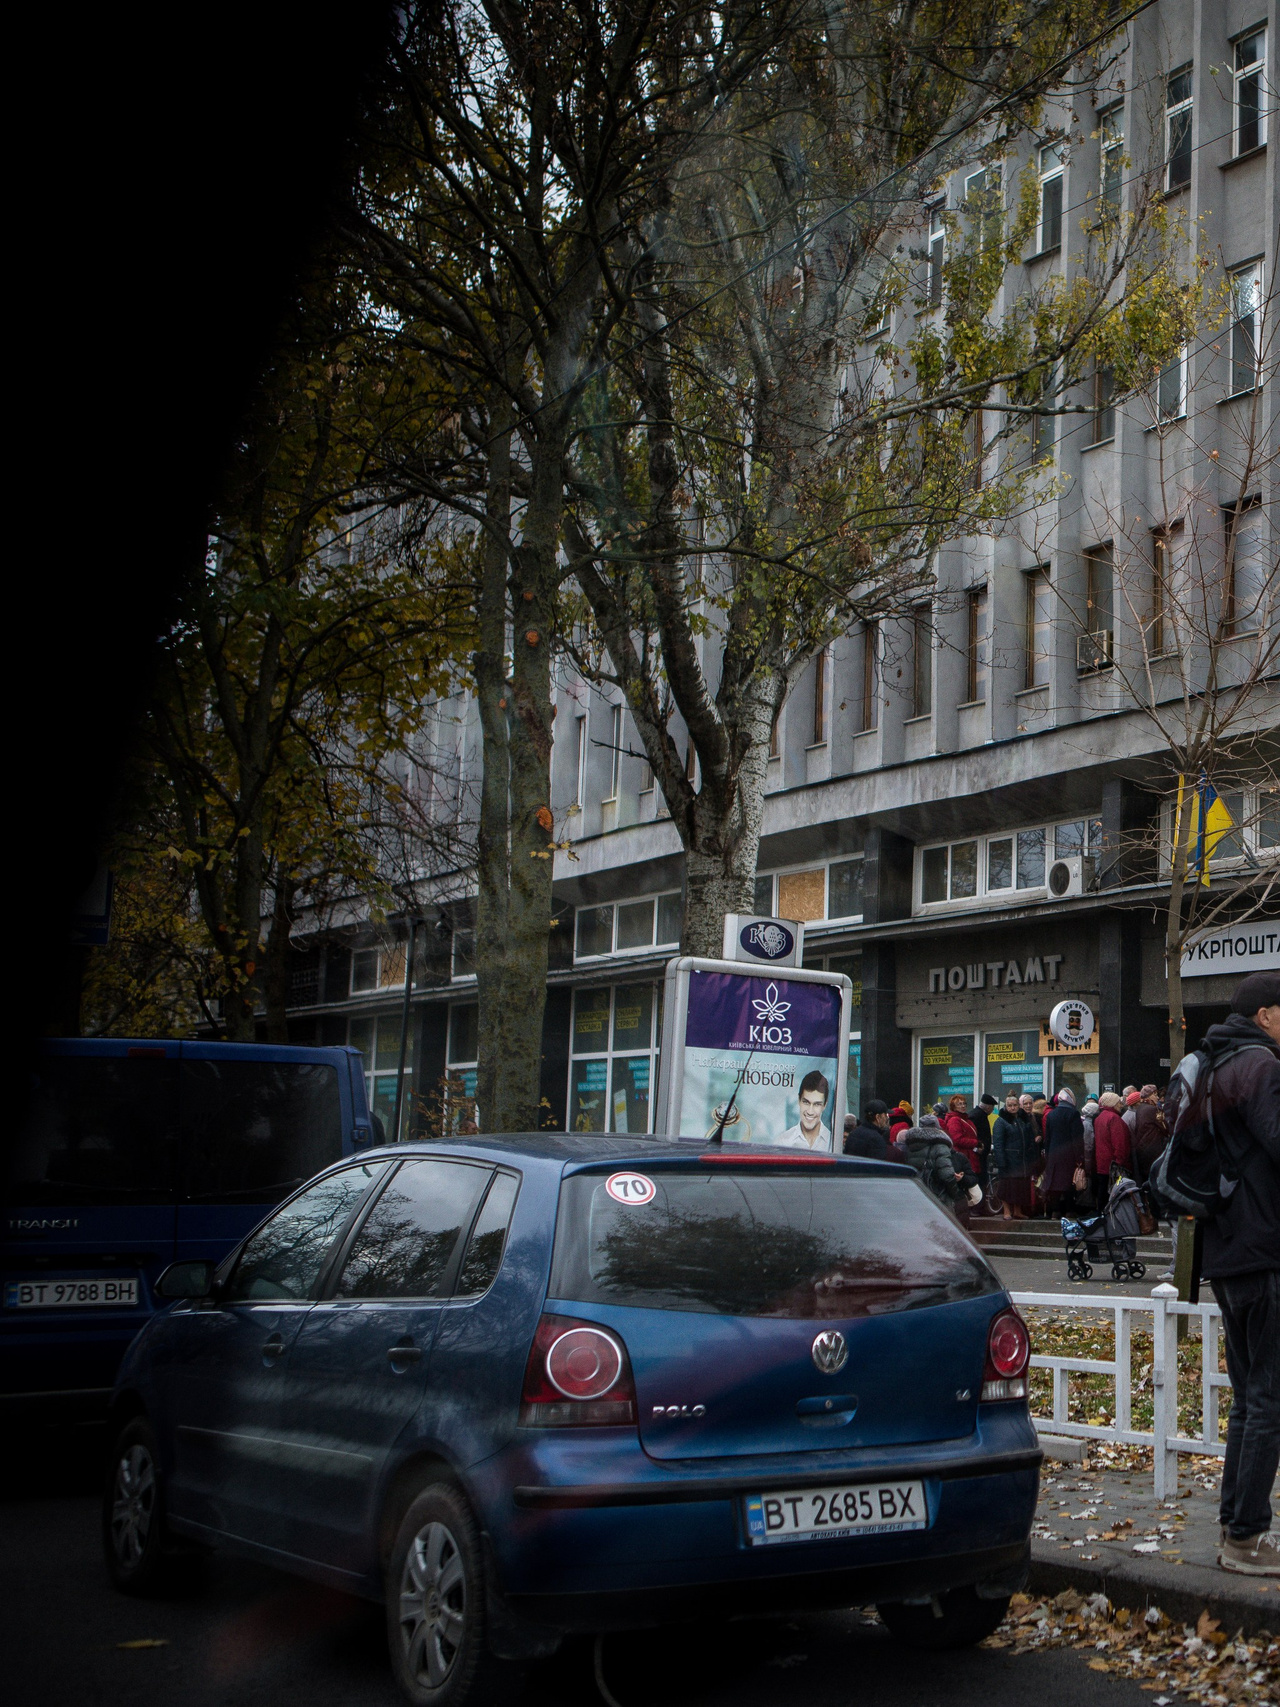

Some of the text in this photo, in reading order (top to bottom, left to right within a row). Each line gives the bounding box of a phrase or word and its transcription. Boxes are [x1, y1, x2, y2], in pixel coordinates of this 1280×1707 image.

[929, 954, 1062, 993] ПОШТАМТ
[749, 1025, 793, 1045] КЮЗ
[793, 1047, 809, 1055] ЗАВОД
[733, 1069, 795, 1088] ЛЮБОВІ
[615, 1179, 648, 1197] 70
[9, 1219, 80, 1228] TRANSIT
[20, 1282, 132, 1303] BT 9788 BH
[652, 1404, 706, 1419] POLO
[764, 1486, 917, 1531] BT 2685 BX
[751, 1520, 764, 1532] UA
